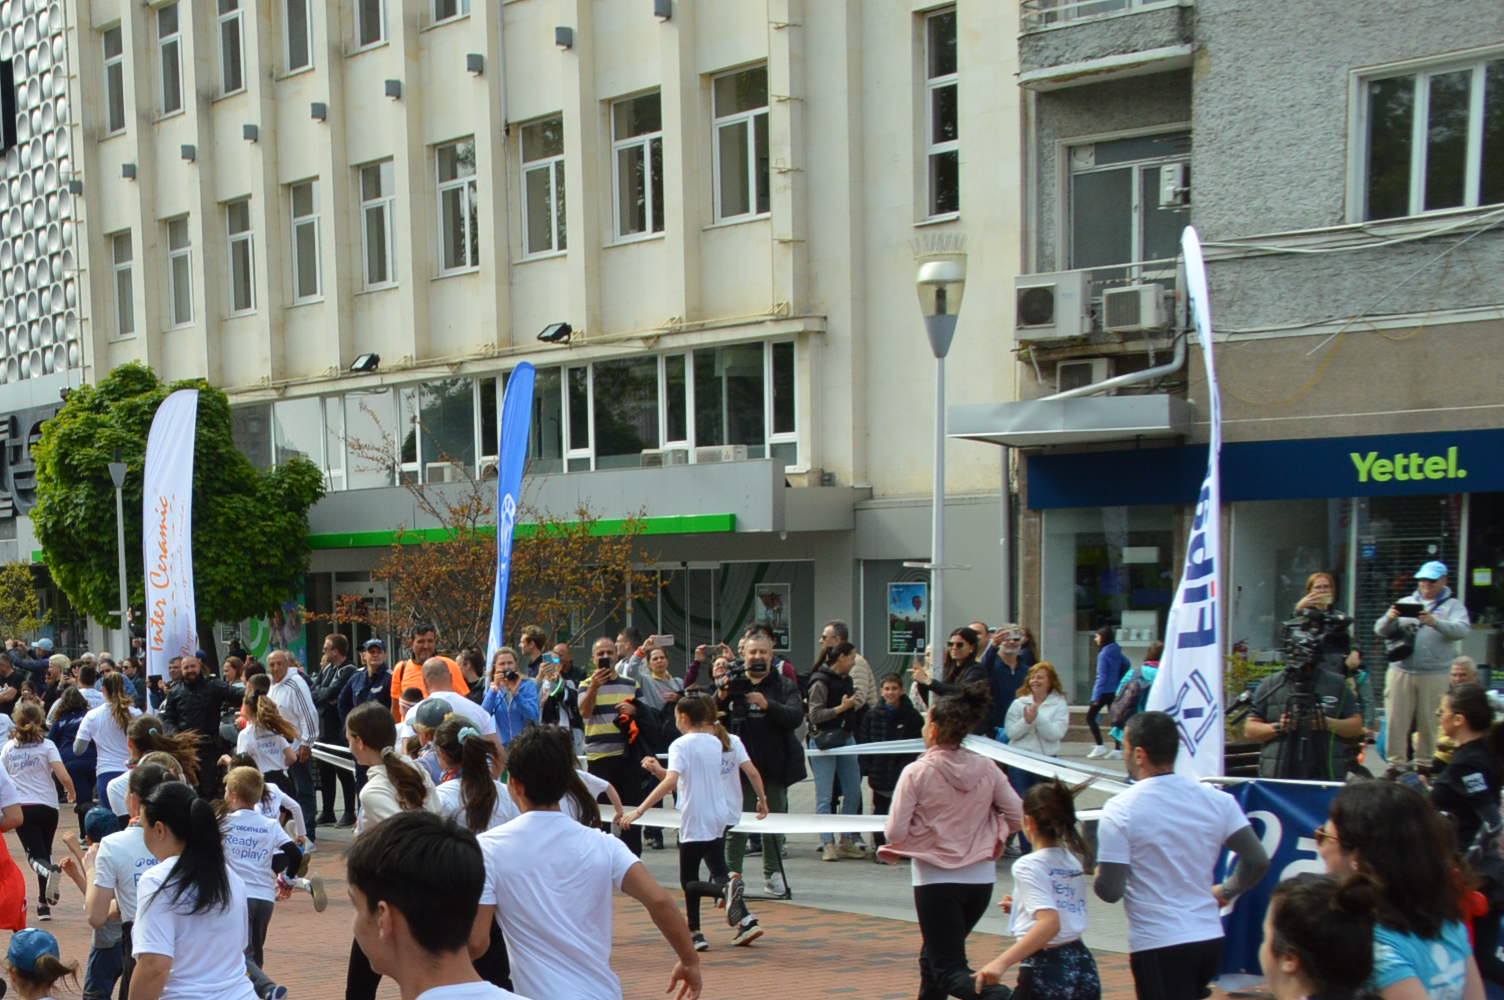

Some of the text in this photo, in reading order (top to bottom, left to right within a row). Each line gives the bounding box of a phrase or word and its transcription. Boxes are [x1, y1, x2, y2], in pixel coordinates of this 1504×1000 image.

[1350, 446, 1468, 482] Yettel.
[149, 495, 170, 652] Inter Ceramic
[225, 834, 258, 847] Ready
[240, 849, 269, 862] play?
